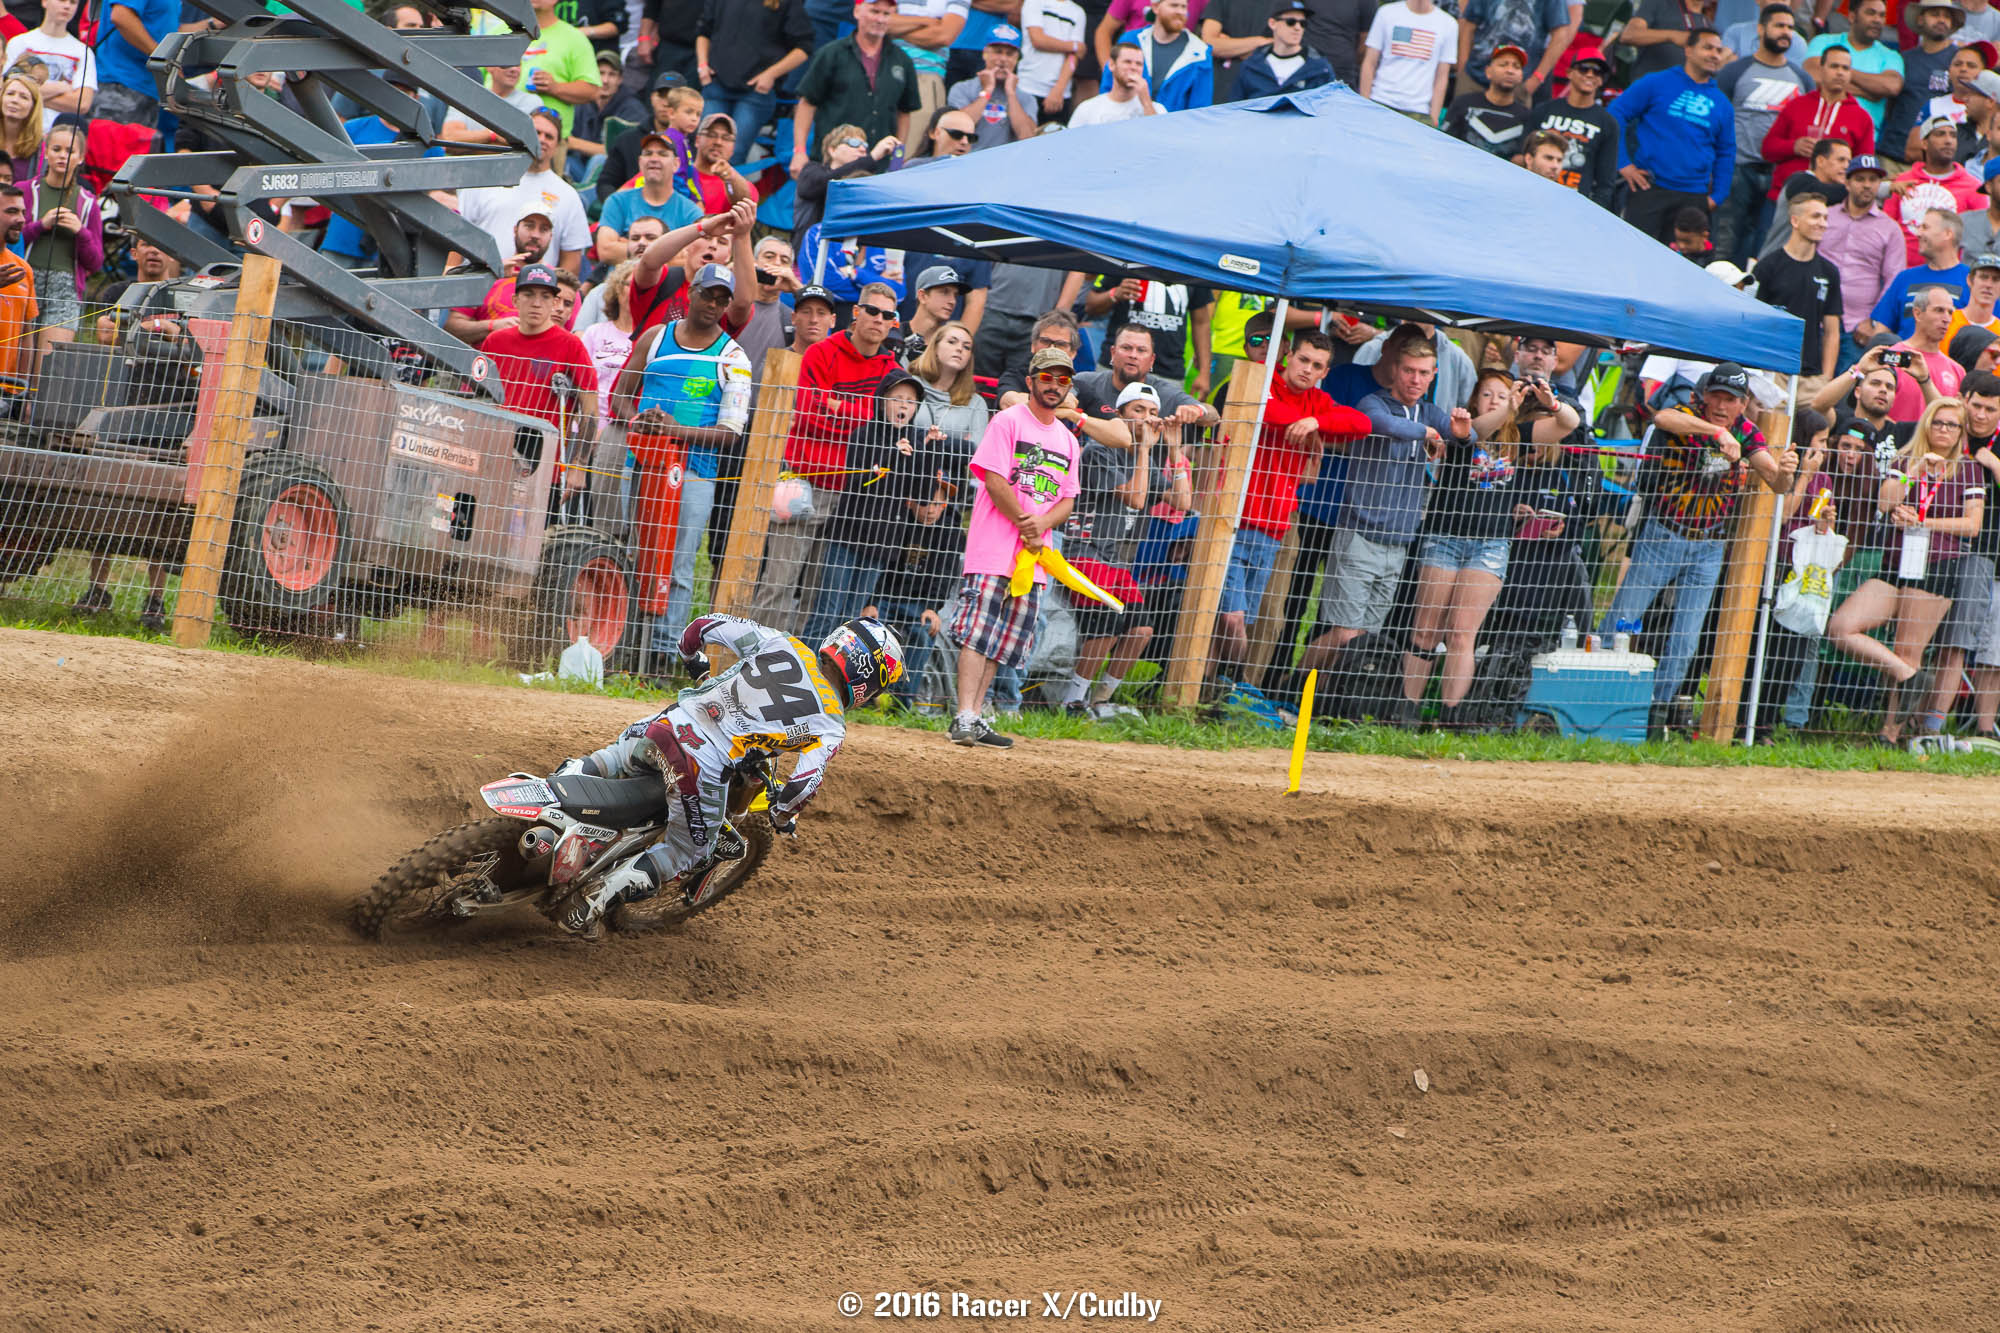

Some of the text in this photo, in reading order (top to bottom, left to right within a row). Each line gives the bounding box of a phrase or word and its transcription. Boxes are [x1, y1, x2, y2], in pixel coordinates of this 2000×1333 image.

[1541, 115, 1601, 139] JUST
[262, 174, 298, 190] SJ6832
[408, 439, 476, 468] United Rentals
[740, 650, 821, 726] 94
[500, 807, 538, 816] DUNLOP
